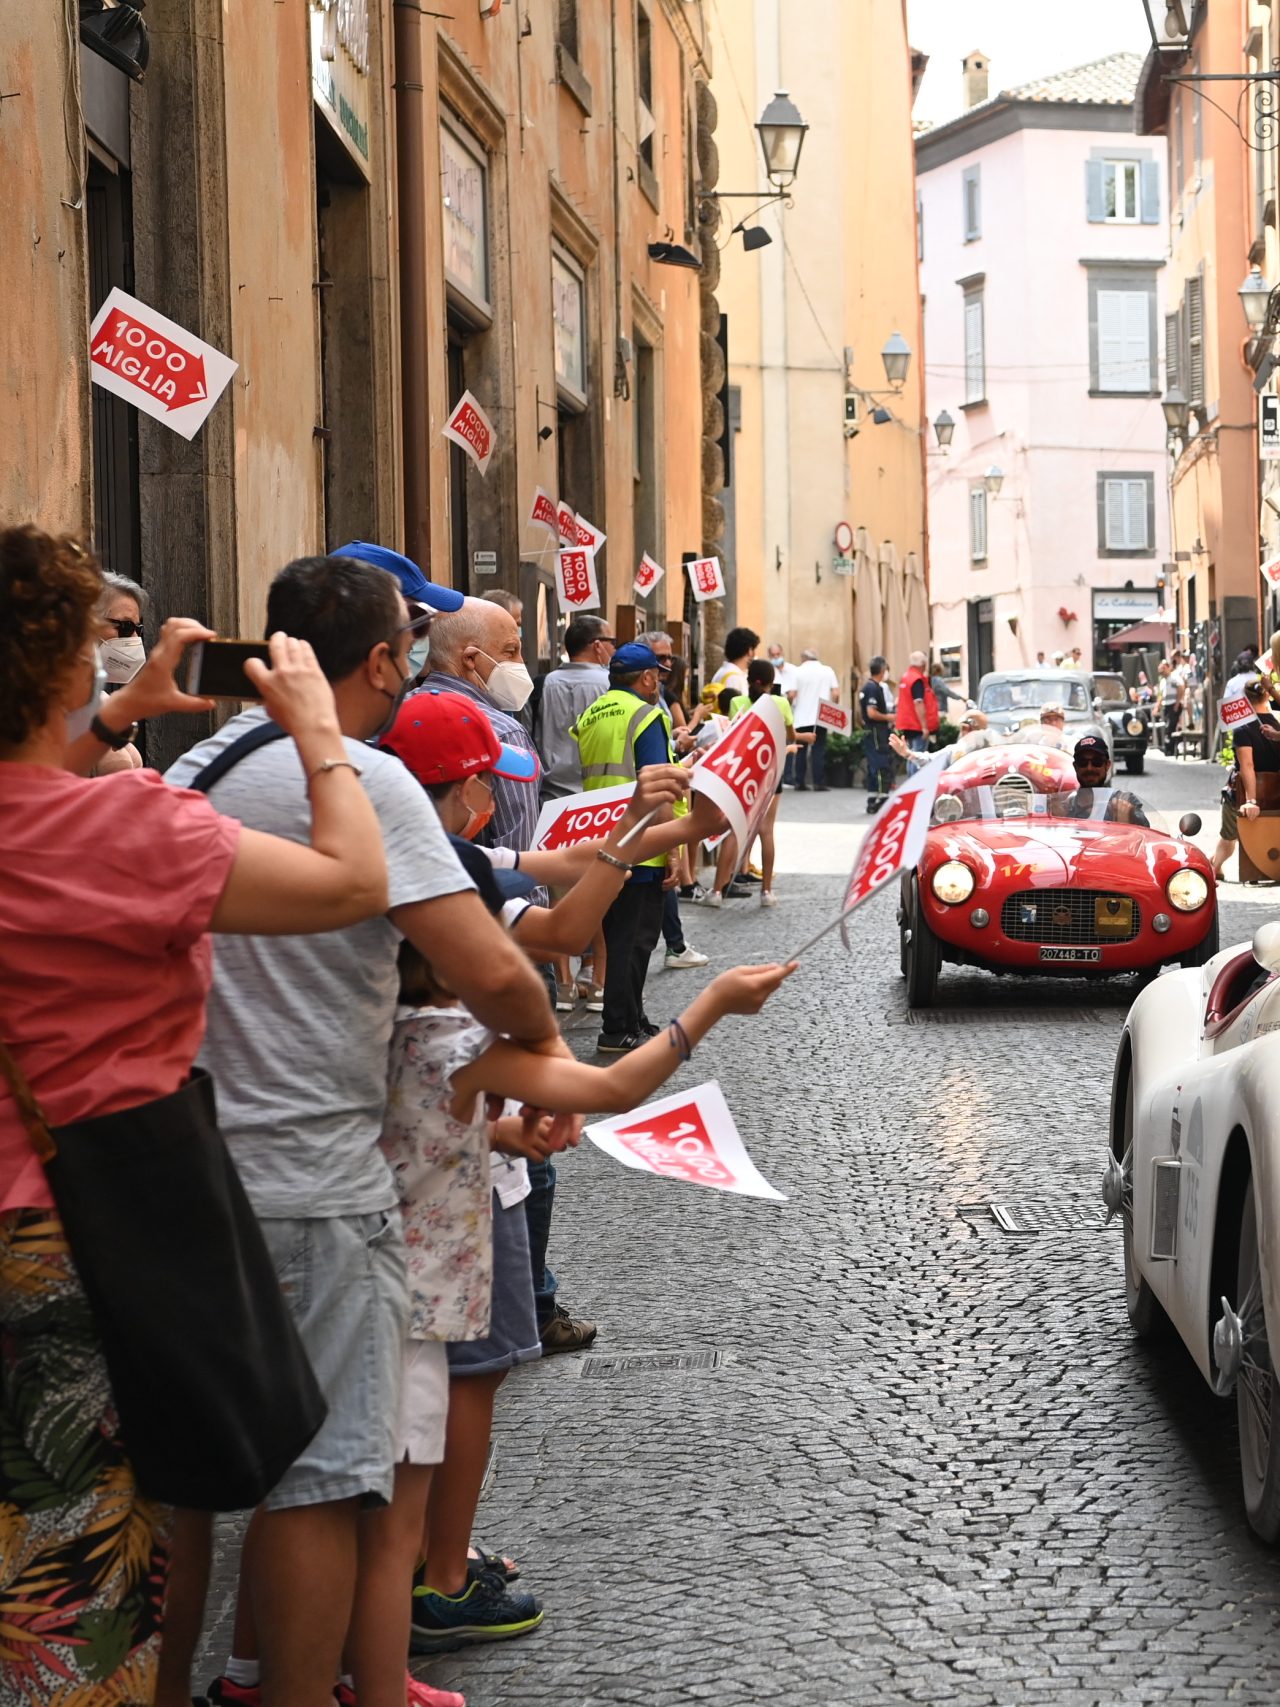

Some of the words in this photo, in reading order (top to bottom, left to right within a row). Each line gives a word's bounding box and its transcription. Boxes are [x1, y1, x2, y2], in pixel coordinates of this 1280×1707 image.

[116, 321, 186, 372] 1000
[92, 341, 176, 401] MIGLIA
[454, 419, 483, 454] MIGLIA
[465, 408, 486, 439] 1000
[562, 555, 576, 595] MIGLIA
[574, 556, 587, 591] 1000
[1224, 700, 1246, 713] 1000
[1225, 707, 1252, 722] MIGLIA
[712, 750, 759, 806] MIG
[567, 803, 628, 833] 1000
[868, 810, 909, 887] 1000
[668, 1122, 727, 1179] 1000
